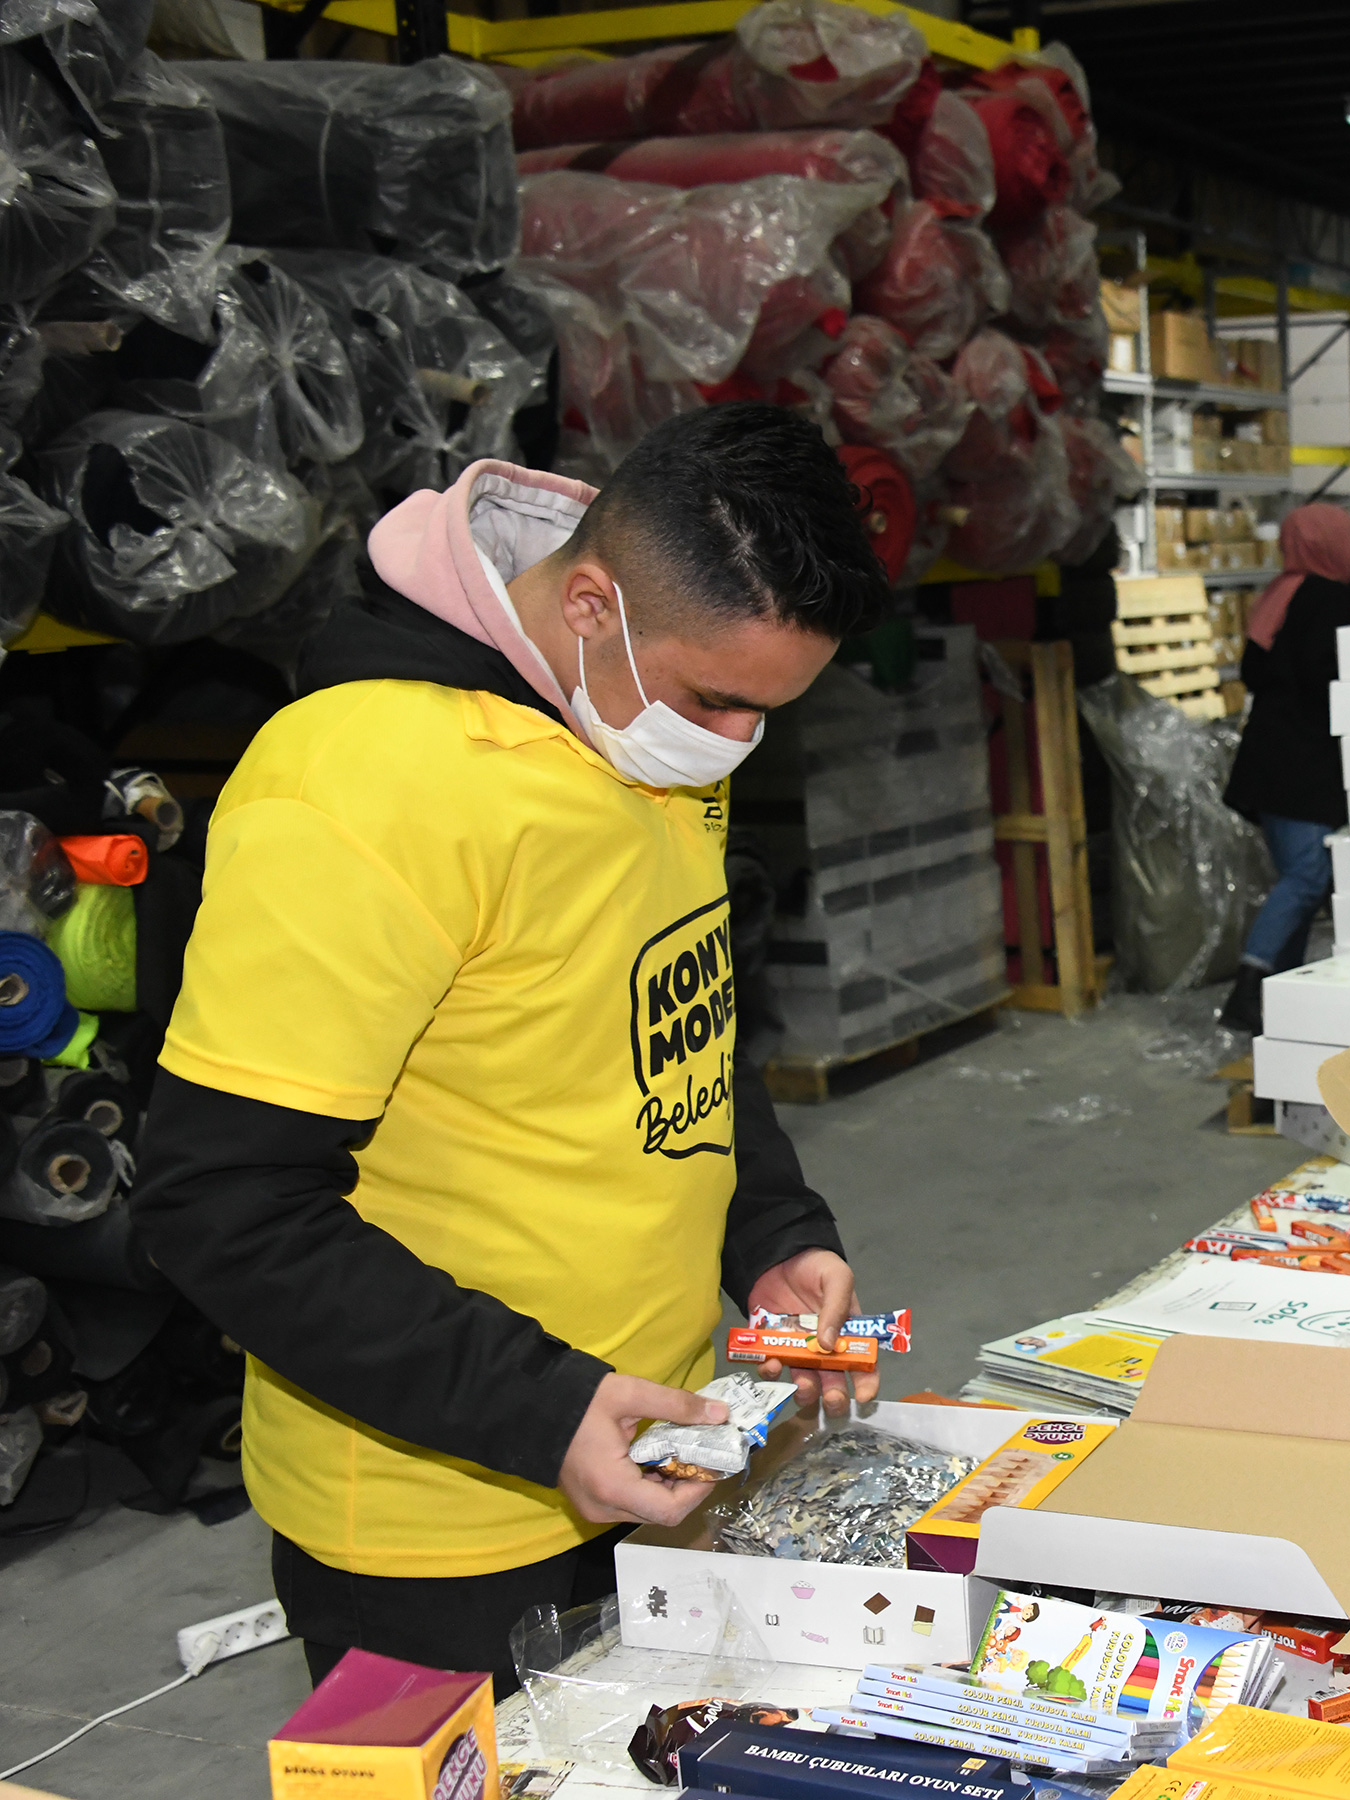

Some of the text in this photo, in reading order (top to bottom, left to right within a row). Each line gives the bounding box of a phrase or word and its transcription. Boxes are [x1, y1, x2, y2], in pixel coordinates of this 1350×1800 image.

[1023, 1432, 1085, 1442] OYUNU
[1026, 1424, 1086, 1432] DENGE
[1095, 1631, 1122, 1682] KURUBOYA
[1113, 1633, 1134, 1678] COLOUR
[891, 1672, 906, 1682] Smart
[1173, 1656, 1197, 1698] Smart
[877, 1700, 893, 1710] Smart
[886, 1687, 901, 1697] Smart
[963, 1689, 995, 1703] COLOUR
[1030, 1702, 1067, 1716] KURUBOYA
[840, 1716, 856, 1726] Smart
[950, 1716, 981, 1730] COLOUR
[1018, 1730, 1056, 1744] KURUBOYA
[958, 1704, 989, 1718] COLOUR
[1025, 1717, 1062, 1731] KURUBOYA
[914, 1731, 946, 1746] COLOUR
[982, 1745, 1020, 1759] KURUBOYA
[744, 1744, 807, 1765] BAMBU
[808, 1756, 906, 1784] ÇUBUKLARI
[909, 1773, 960, 1793] OYUN
